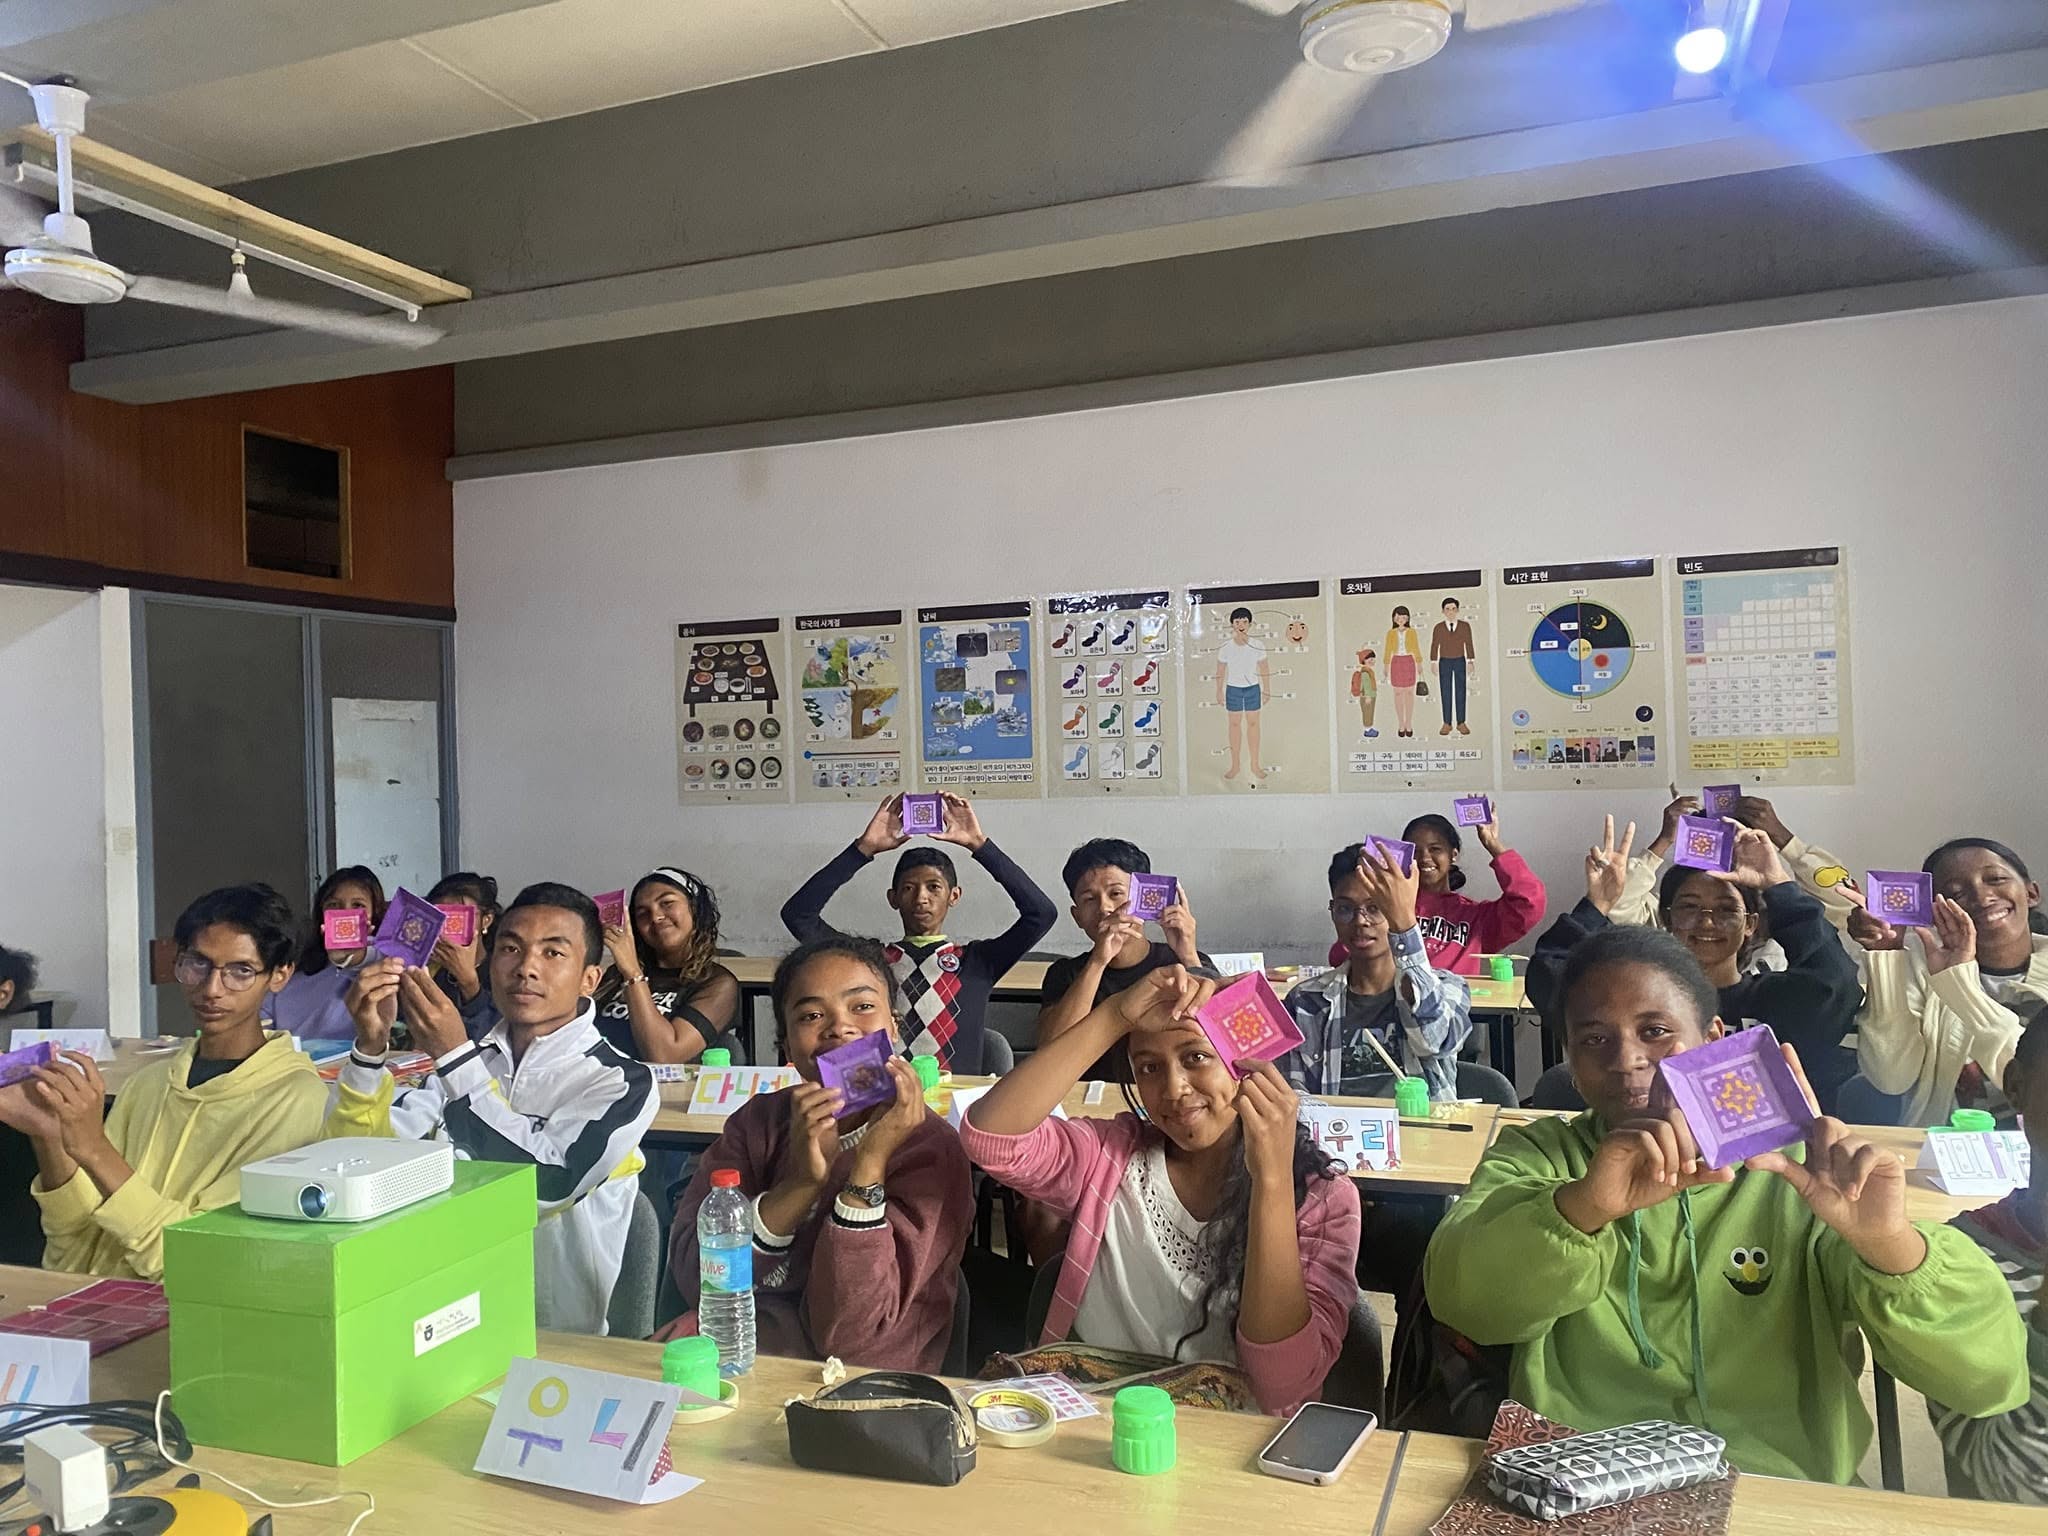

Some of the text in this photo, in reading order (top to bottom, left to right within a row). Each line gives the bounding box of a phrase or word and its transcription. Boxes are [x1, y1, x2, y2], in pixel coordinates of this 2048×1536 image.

[1684, 562, 1703, 573] 빈도
[1510, 570, 1549, 583] 시간 표현
[1346, 582, 1372, 594] 옷차림
[922, 612, 937, 622] 날씨
[800, 618, 840, 629] 한국의 사계절
[988, 1395, 1001, 1404] 3M
